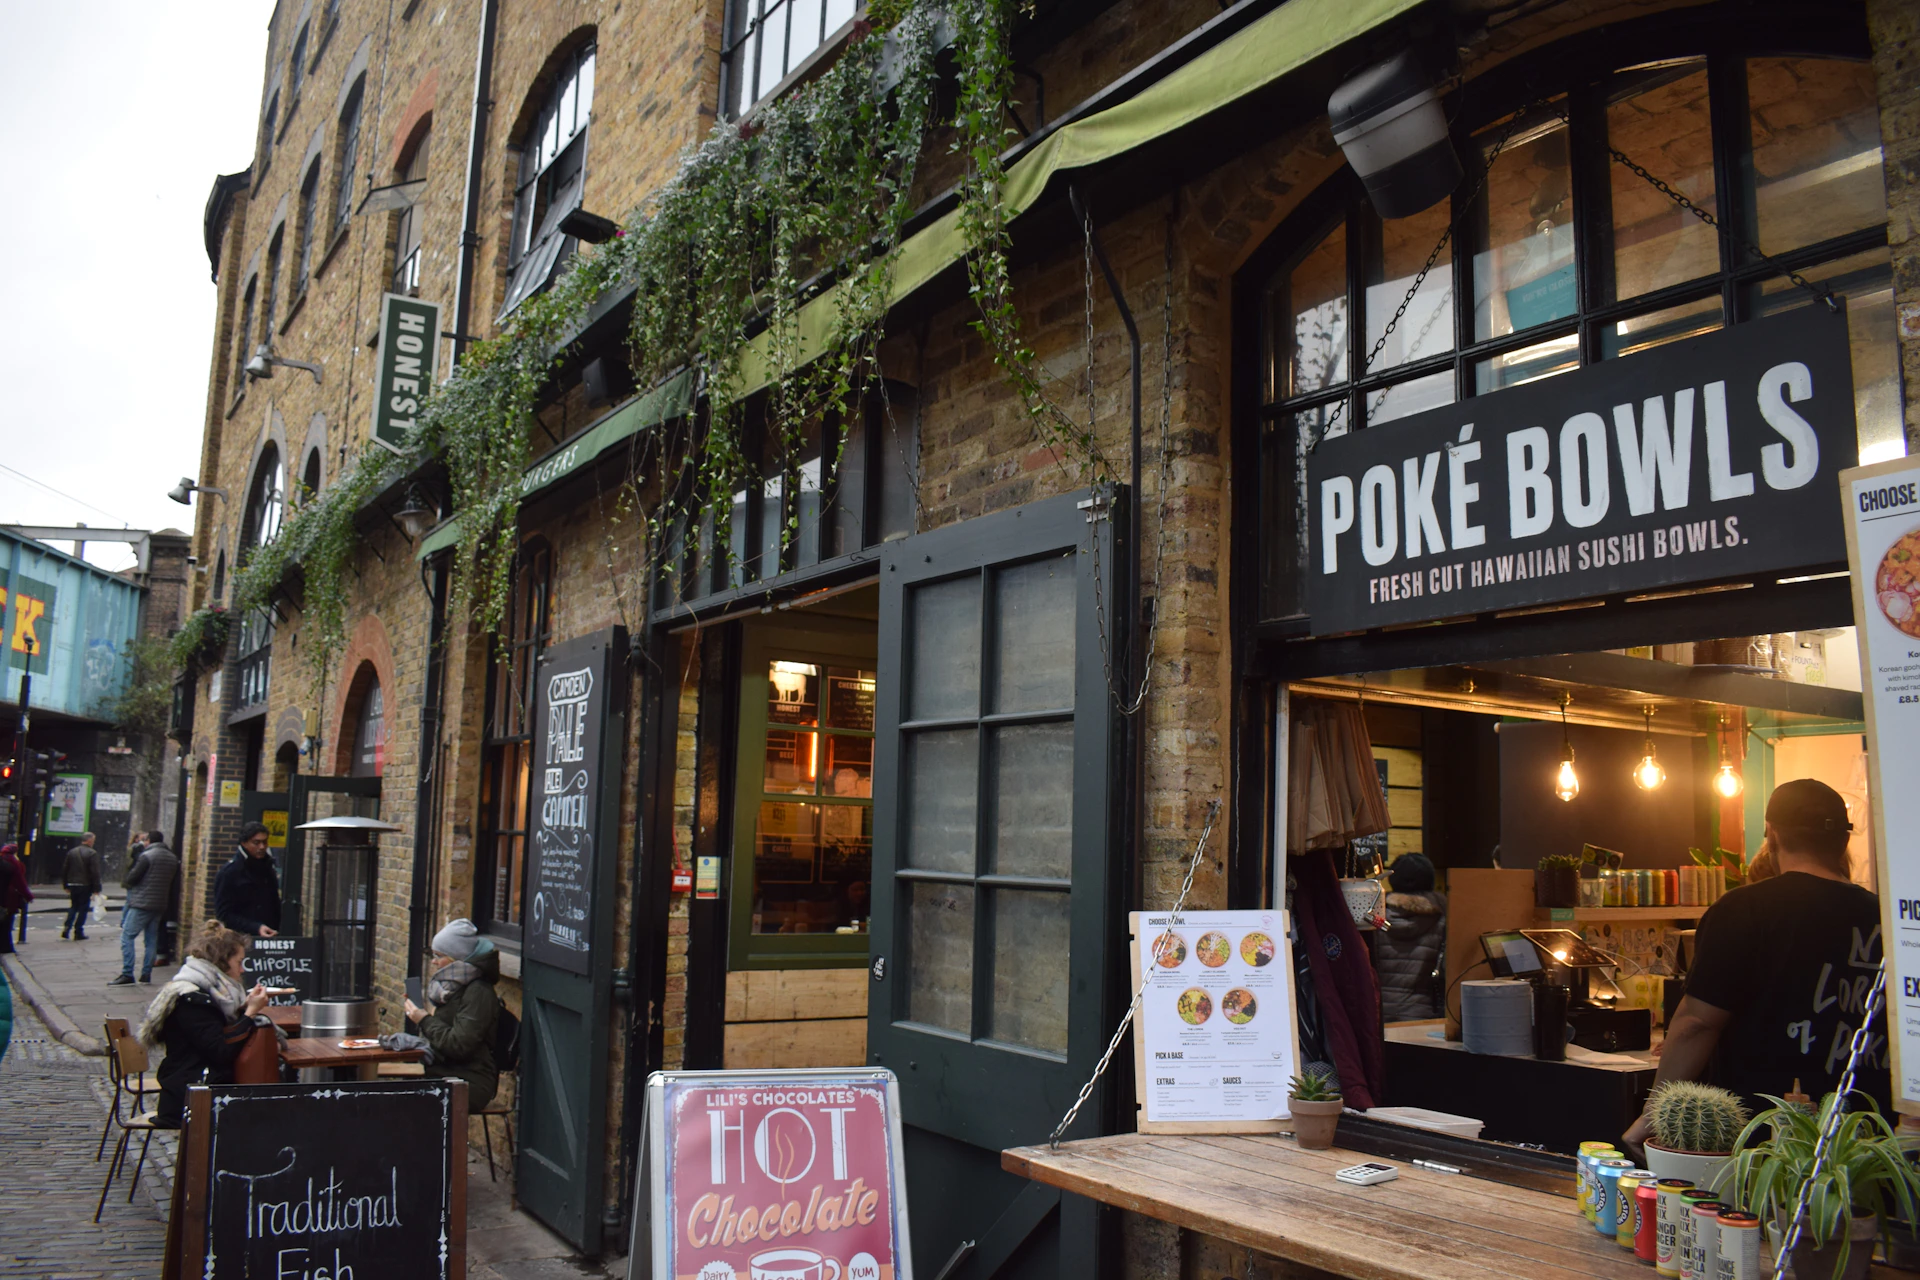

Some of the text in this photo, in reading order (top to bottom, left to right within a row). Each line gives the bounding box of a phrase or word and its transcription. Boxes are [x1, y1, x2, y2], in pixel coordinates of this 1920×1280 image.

[389, 312, 426, 429] HONEST
[517, 445, 579, 492] URGERS
[1321, 362, 1820, 575] POKÉ BOWLS
[1859, 482, 1918, 513] CHOOSE
[1369, 515, 1749, 604] FRESH CUT HAWAIIAN SUSHI BOWLS.
[552, 673, 586, 700] CAMDEN
[838, 682, 860, 690] CHEESE
[546, 771, 561, 791] ALE
[542, 793, 589, 830] CAMDEN
[1149, 918, 1167, 926] CHOOSE
[255, 940, 296, 950] HONEST
[1155, 1051, 1167, 1060] PICK
[1171, 1051, 1184, 1060] BASE
[1156, 1077, 1176, 1086] EXTRAS
[1222, 1076, 1242, 1085] SAUCES
[706, 1091, 856, 1107] LILI'S CHOCOLATES
[706, 1107, 856, 1185] HOT
[216, 1146, 403, 1239] Traditional
[687, 1176, 880, 1249] Chocolate
[704, 1271, 730, 1280] Dairy
[851, 1267, 875, 1279] YUM
